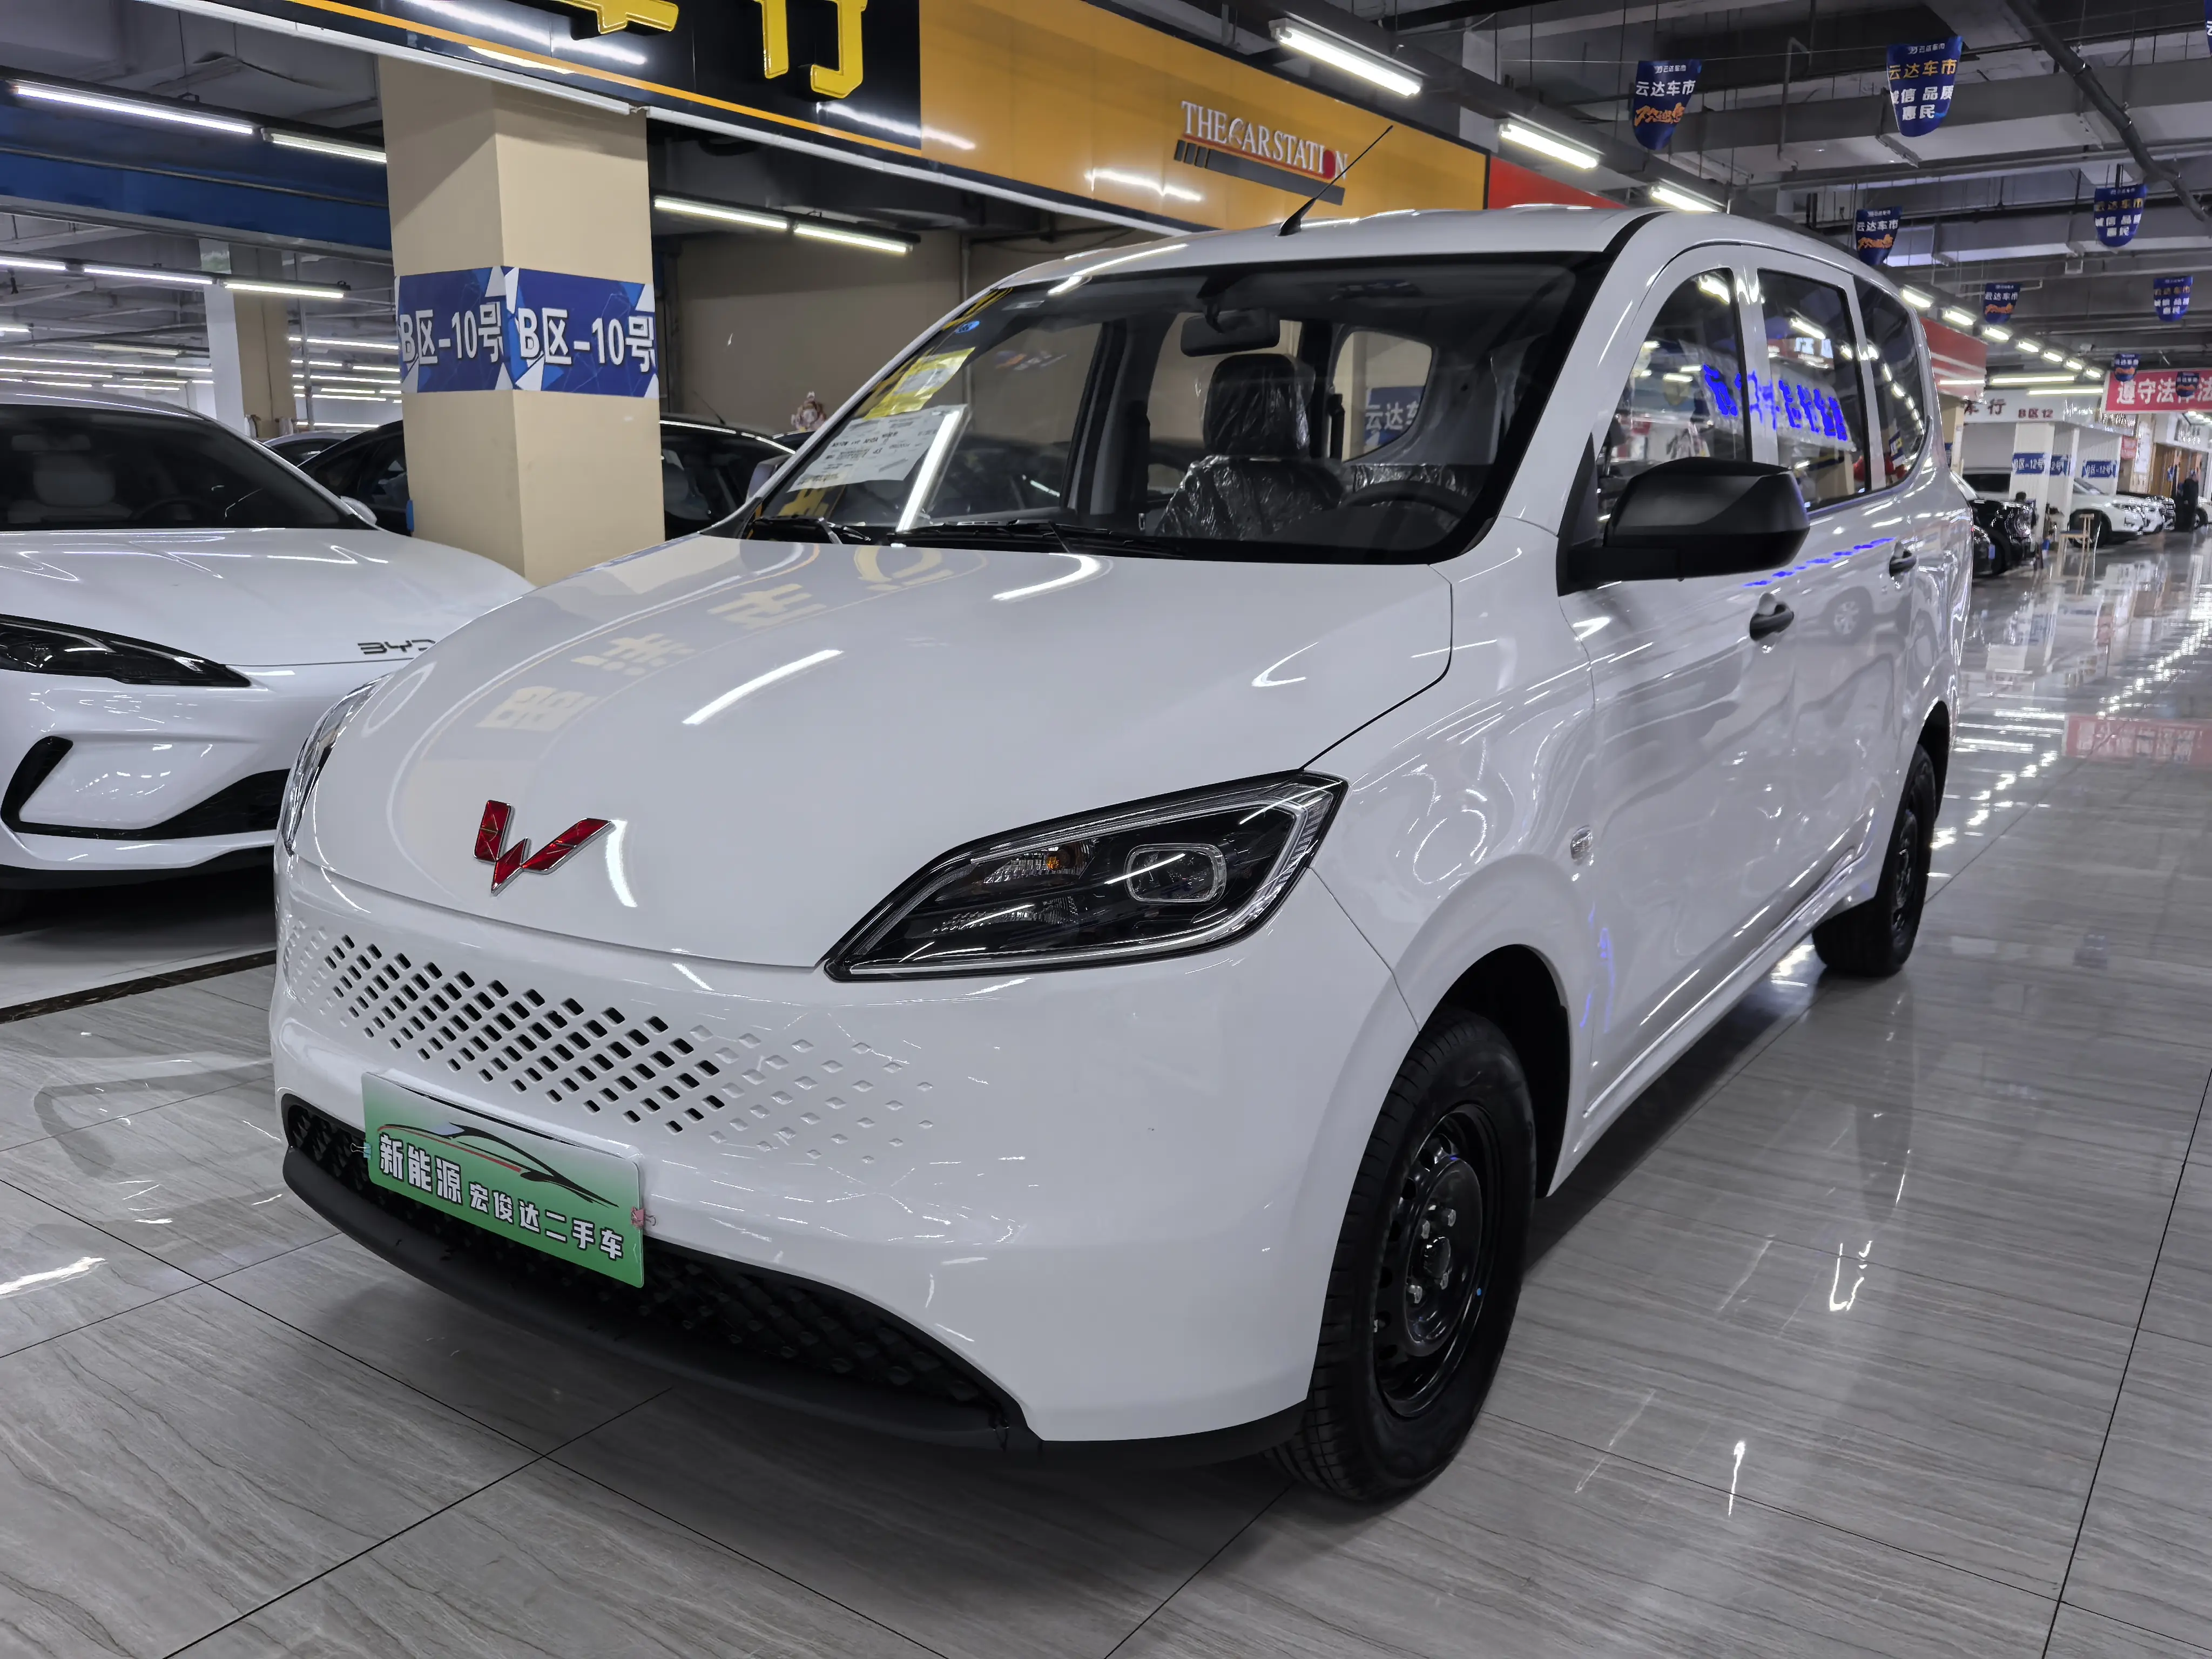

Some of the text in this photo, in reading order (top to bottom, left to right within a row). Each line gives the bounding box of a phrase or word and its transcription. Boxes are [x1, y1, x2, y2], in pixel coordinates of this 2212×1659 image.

[1889, 59, 1957, 80] 云达车市
[1636, 79, 1696, 97] 云达车市
[1857, 219, 1899, 232] 云达车市
[400, 301, 503, 365] B区-10号
[518, 307, 655, 373] B区-10号
